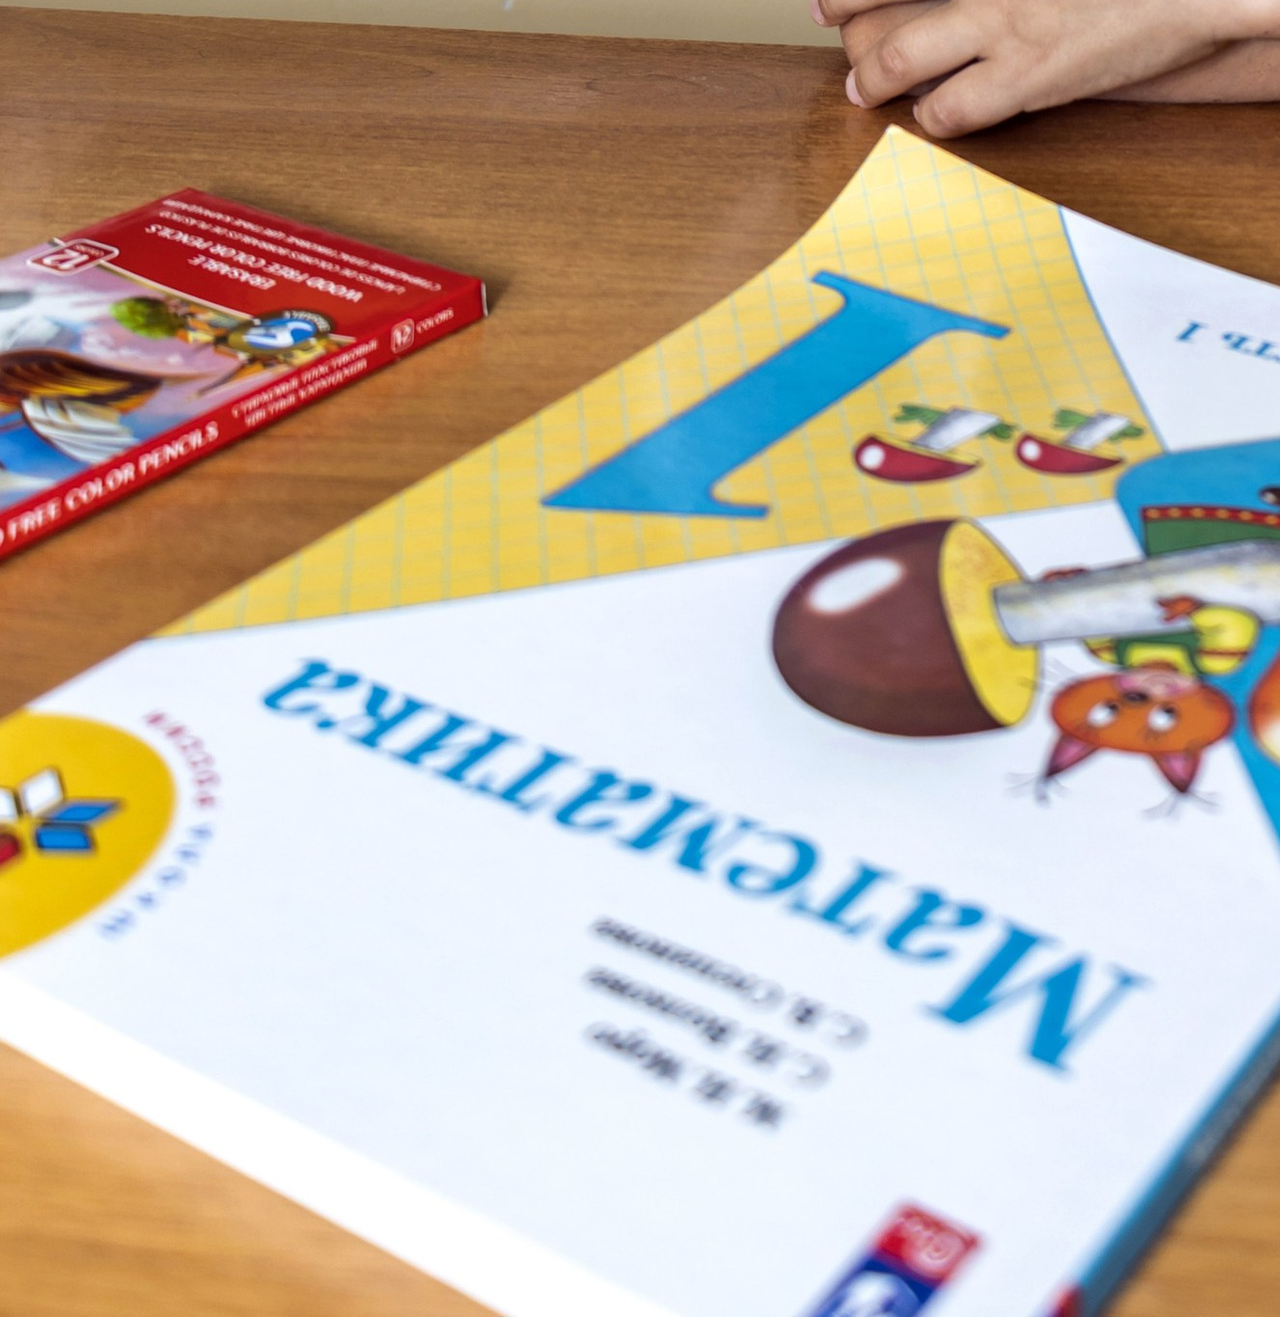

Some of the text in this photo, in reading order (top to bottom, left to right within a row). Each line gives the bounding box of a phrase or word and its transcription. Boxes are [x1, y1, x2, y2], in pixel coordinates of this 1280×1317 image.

[145, 223, 364, 304] WOOD FREE COLOR PENCILS
[187, 253, 277, 291] ERASABLE
[541, 270, 1012, 519] 1
[6, 491, 62, 542] FREE
[65, 455, 136, 512] COLOR
[139, 421, 219, 477] PENCILS
[261, 657, 1155, 1078] Математика
